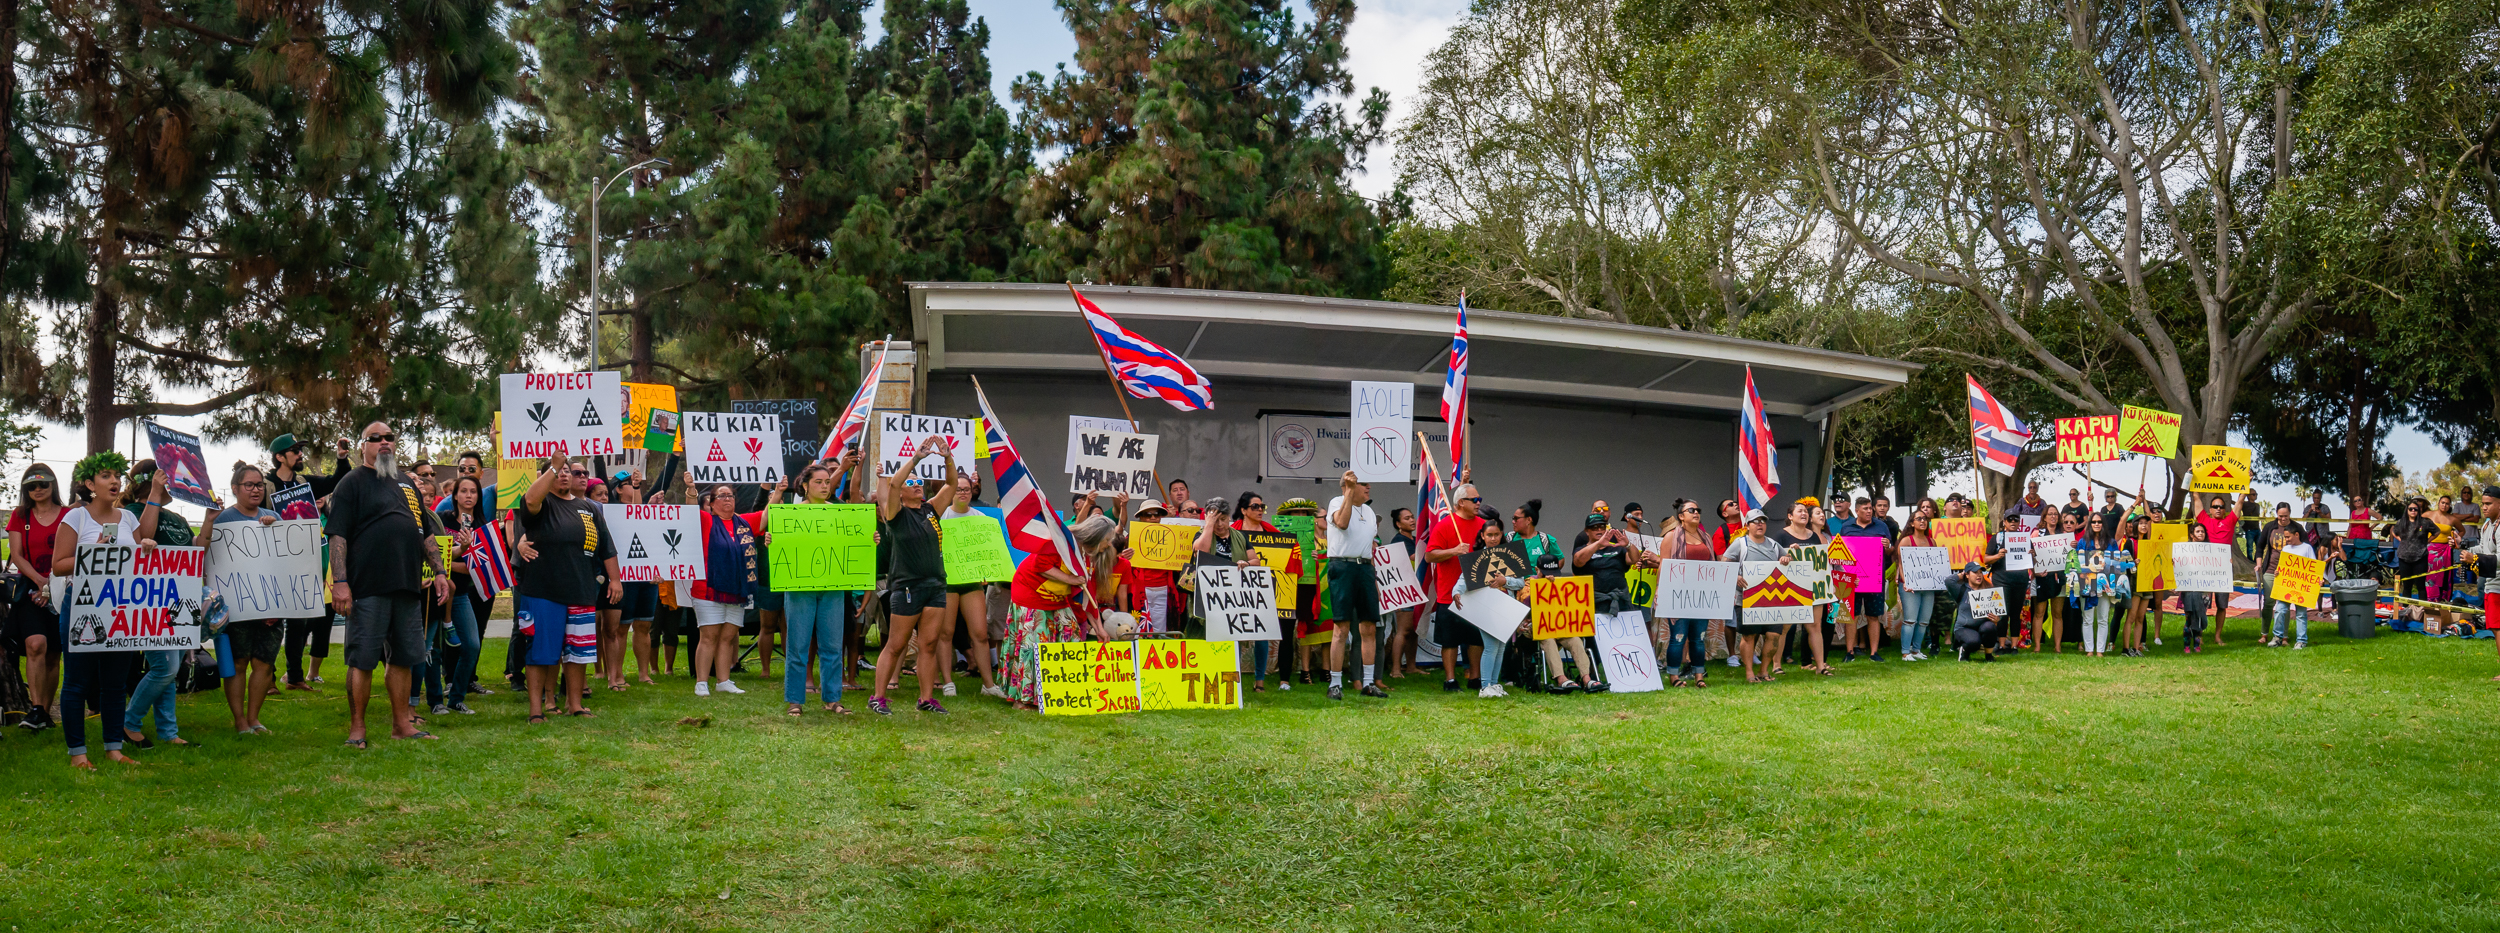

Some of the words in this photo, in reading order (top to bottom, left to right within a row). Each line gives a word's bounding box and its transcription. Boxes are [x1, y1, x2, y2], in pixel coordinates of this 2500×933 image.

[525, 373, 594, 391] PROTECT
[2058, 417, 2114, 435] KAPU
[580, 437, 614, 455] KEA
[1081, 433, 1110, 457] WE
[1117, 437, 1145, 460] ARE
[1362, 437, 1396, 465] TMT
[2058, 436, 2119, 462] ALOHA
[2195, 456, 2224, 469] STAND
[2227, 457, 2247, 472] WITH
[1074, 465, 1127, 492] MAUNA
[1131, 470, 1151, 496] KEA
[2194, 482, 2224, 490] MAUNA
[2228, 483, 2246, 491] KEA
[626, 505, 681, 520] PROTECT
[771, 514, 828, 534] LEAVE
[835, 518, 864, 536] HER
[1934, 521, 1986, 539] ALOHA
[209, 524, 318, 565] PROTECT
[1248, 534, 1275, 544] LAWA
[2033, 538, 2068, 549] PROTECT
[75, 545, 132, 576] KEEP
[133, 547, 205, 578] HAWAII
[773, 545, 872, 579] ALONE
[1507, 549, 1526, 570] together
[1908, 550, 1944, 567] Protect
[1942, 544, 1984, 564] INA
[2036, 556, 2067, 567] MAUN
[2064, 549, 2136, 574] ALOHA
[2285, 554, 2317, 573] SAVE
[670, 565, 696, 580] KEA
[1201, 569, 1233, 588] WE
[1240, 569, 1269, 588] ARE
[1744, 564, 1766, 576] WE
[1786, 564, 1812, 578] ARE
[1841, 573, 1851, 583] ARE
[2278, 565, 2320, 586] MAUNAKEA
[95, 577, 179, 607] ALOHA
[215, 572, 287, 613] MAUNA
[289, 574, 325, 611] KEA
[1535, 581, 1590, 607] KAPU
[2282, 579, 2297, 589] FOR
[2301, 584, 2311, 593] ME
[1206, 590, 1268, 611] MAUNA
[1672, 589, 1720, 610] MAUNA
[1226, 612, 1267, 635] KEA
[1537, 609, 1596, 635] ALOHA
[1744, 609, 1784, 624] MAUNA
[1790, 608, 1813, 620] KEA
[105, 637, 192, 648] #PROTECTMAUNAKEA
[1040, 643, 1089, 662] Protect
[1142, 641, 1199, 670] A'ole
[1612, 651, 1643, 678] TMT
[1042, 664, 1089, 683] Protect
[1095, 662, 1137, 683] Culture
[1182, 671, 1240, 705] TMT
[1044, 689, 1093, 708] Protect
